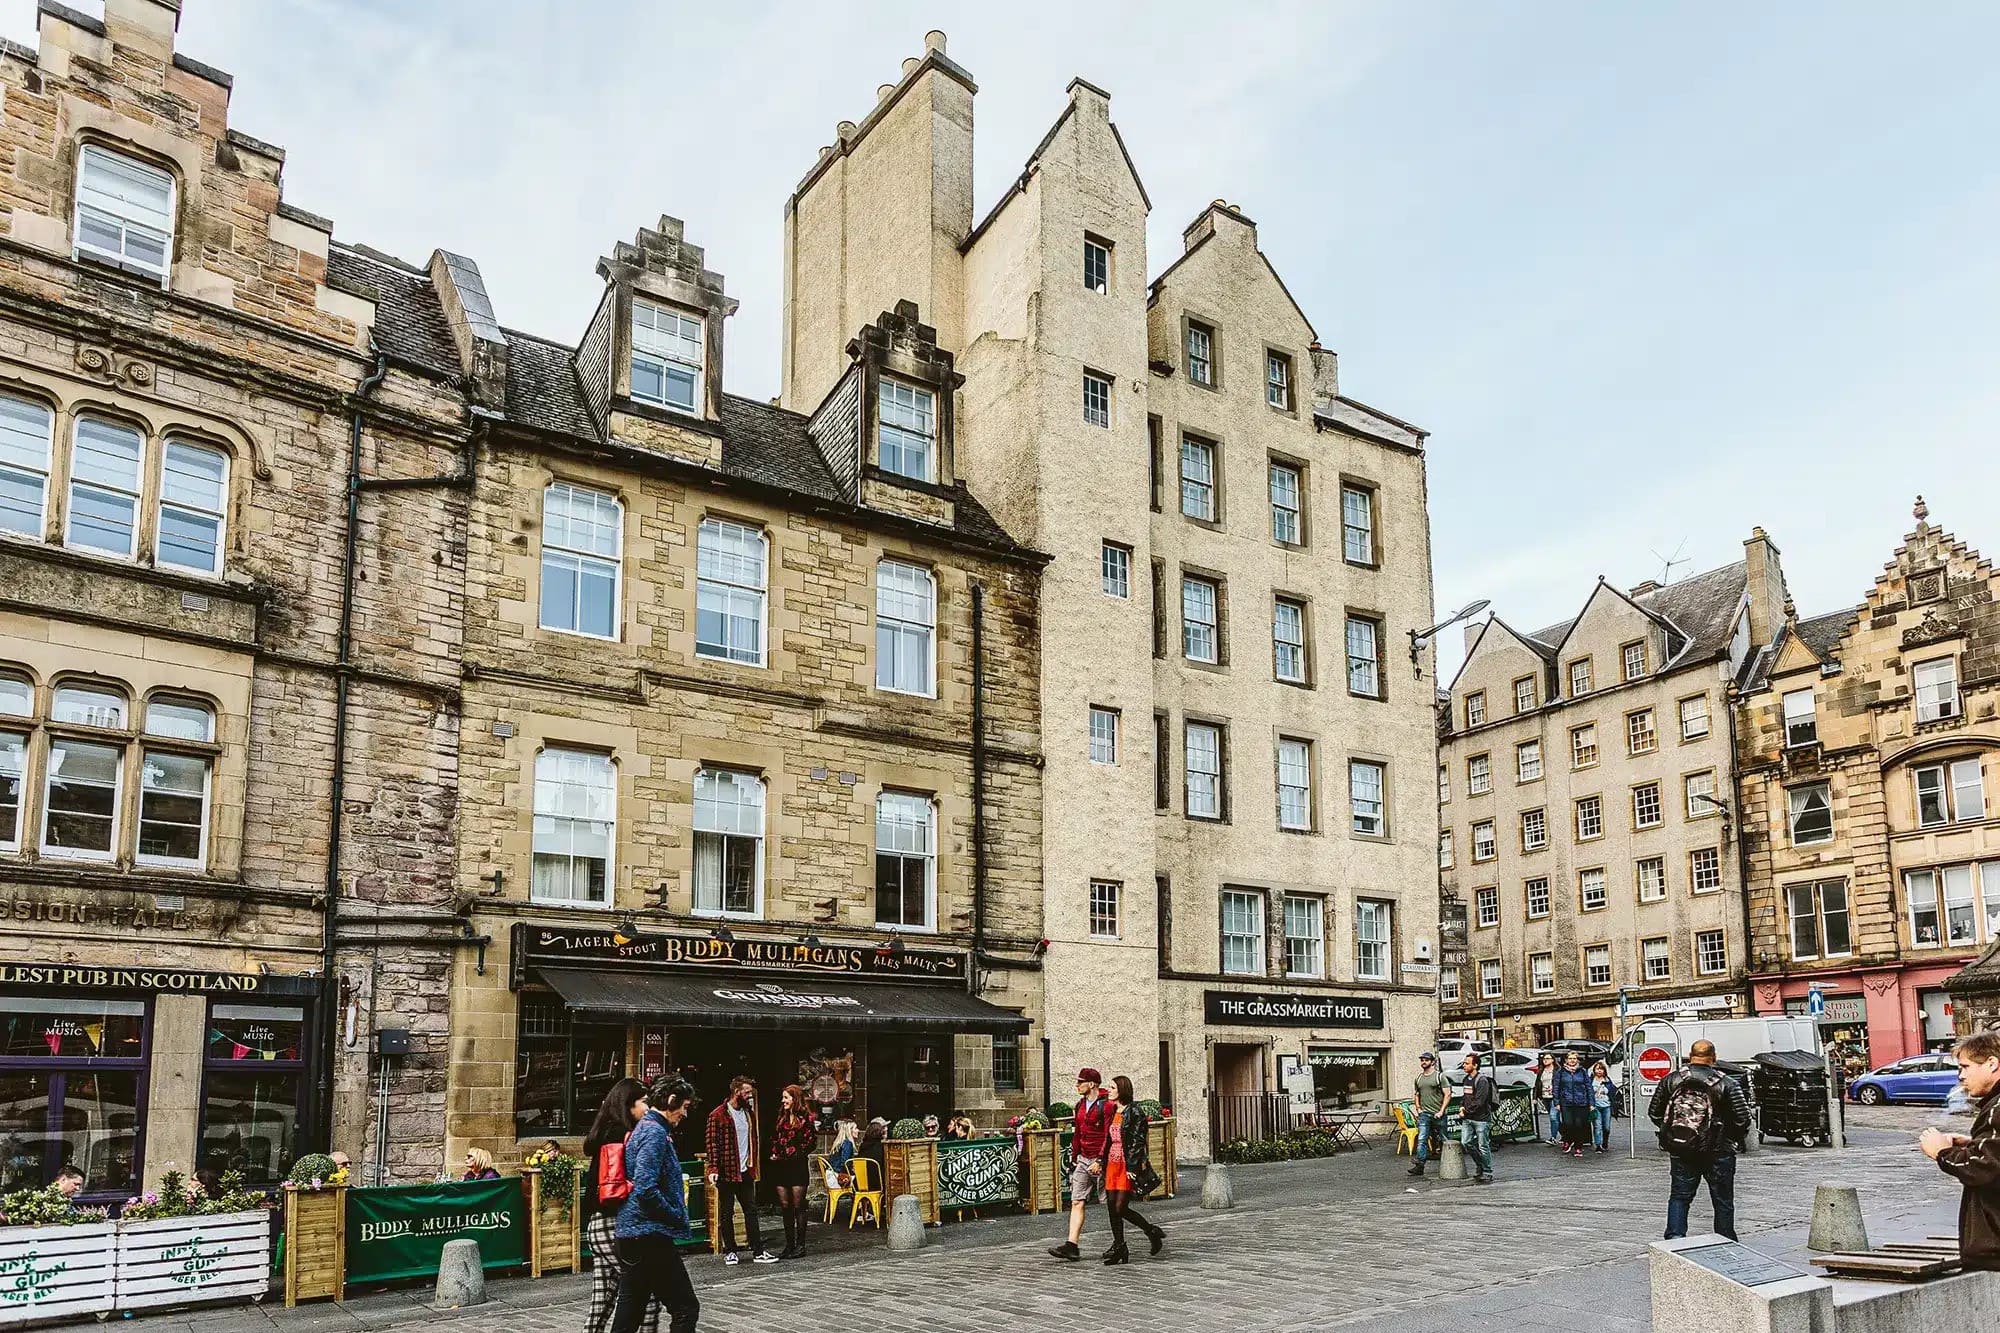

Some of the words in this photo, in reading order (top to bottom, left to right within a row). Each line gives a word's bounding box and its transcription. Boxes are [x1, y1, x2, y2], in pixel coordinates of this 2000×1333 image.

[541, 932, 552, 940] 96
[565, 936, 620, 949] LAGERS
[620, 943, 657, 956] STOUT
[665, 938, 736, 962] BIDDY
[747, 943, 862, 972] MULLIGANS
[741, 959, 796, 969] GRASSMARKET
[873, 955, 901, 970] ALES
[904, 955, 938, 973] MALTS
[0, 966, 60, 984] LEST
[62, 969, 108, 986] PUB
[113, 972, 141, 987] IN
[140, 972, 257, 991] SCOTLAND
[713, 989, 862, 1006] GUINNESS
[1645, 1001, 1680, 1012] Knights
[1220, 1000, 1245, 1015] THE
[1247, 1001, 1334, 1018] GRASSMARKET
[1335, 1005, 1372, 1019] HOTEL
[1825, 1010, 1860, 1021] Shop
[45, 1028, 83, 1036] MUSIC
[54, 1019, 76, 1028] Live
[249, 1025, 269, 1033] Live
[948, 1148, 981, 1176] INNIS
[971, 1161, 981, 1174] &
[966, 1160, 1001, 1187] GUNN
[954, 1184, 978, 1200] LAGER
[979, 1180, 997, 1198] BEER
[360, 1219, 413, 1242] BIDDY
[421, 1210, 512, 1231] MULLIGANS
